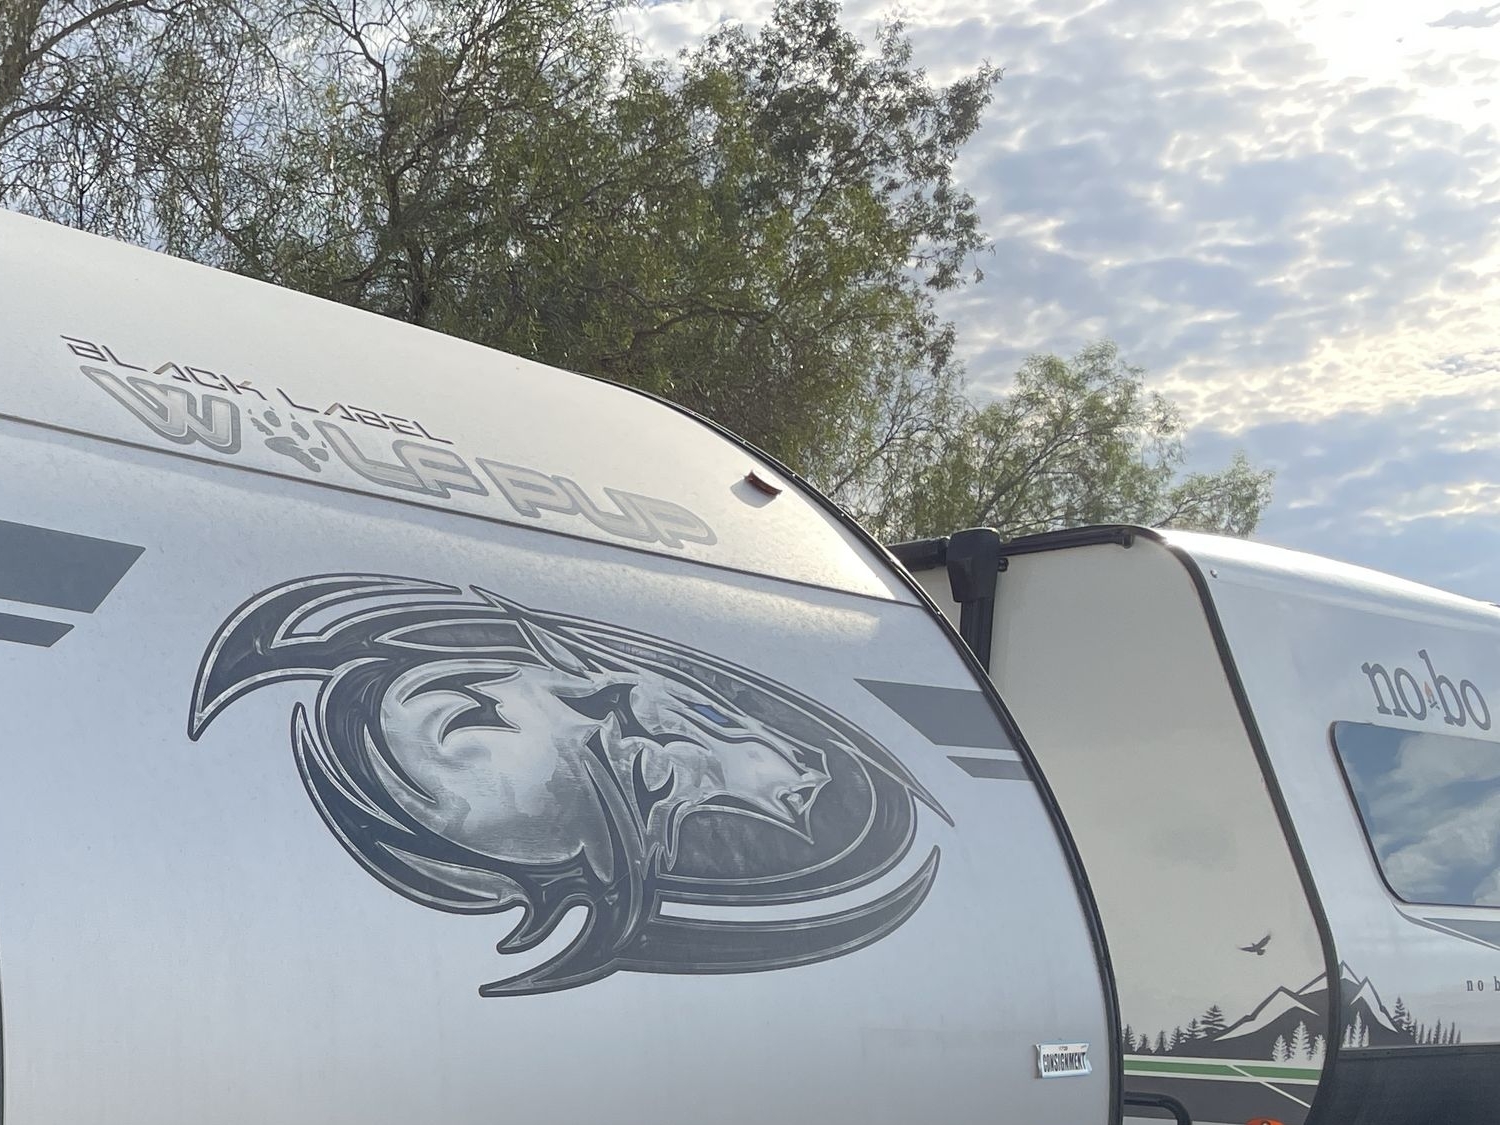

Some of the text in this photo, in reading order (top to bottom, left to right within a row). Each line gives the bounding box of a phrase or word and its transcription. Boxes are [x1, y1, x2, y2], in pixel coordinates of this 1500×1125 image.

[60, 334, 455, 445] BLACK LABEL
[476, 456, 718, 548] PUP
[1042, 1052, 1086, 1073] CONSIGNMENT
